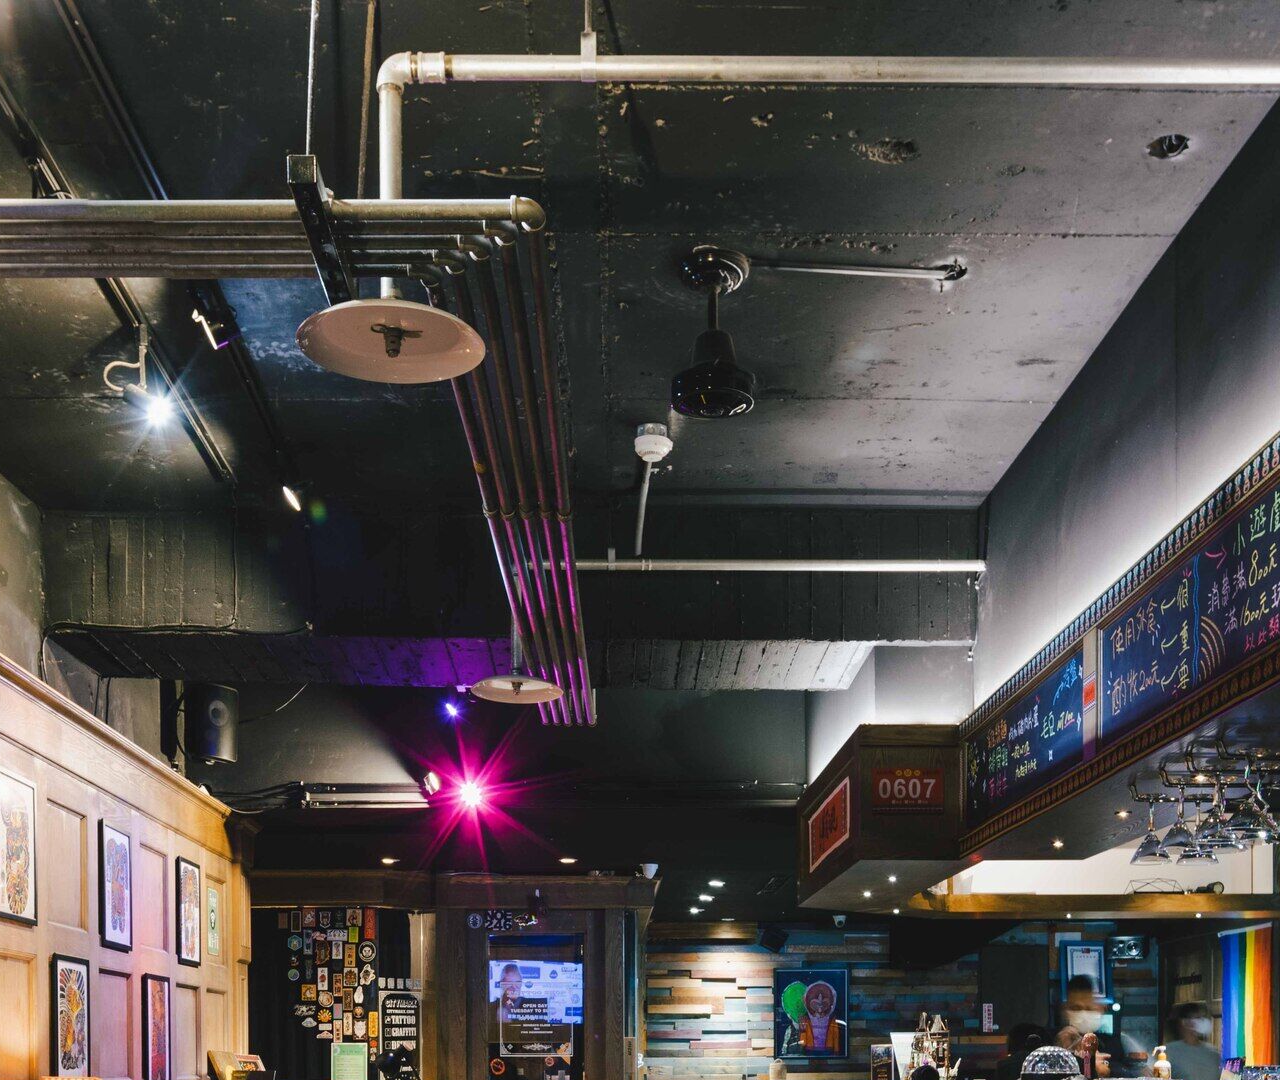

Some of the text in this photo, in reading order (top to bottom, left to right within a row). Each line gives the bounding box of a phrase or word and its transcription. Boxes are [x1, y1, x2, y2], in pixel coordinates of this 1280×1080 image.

[878, 778, 936, 799] 0607
[391, 1015, 416, 1025] TATTOO
[391, 1027, 417, 1037] GRAFFITI
